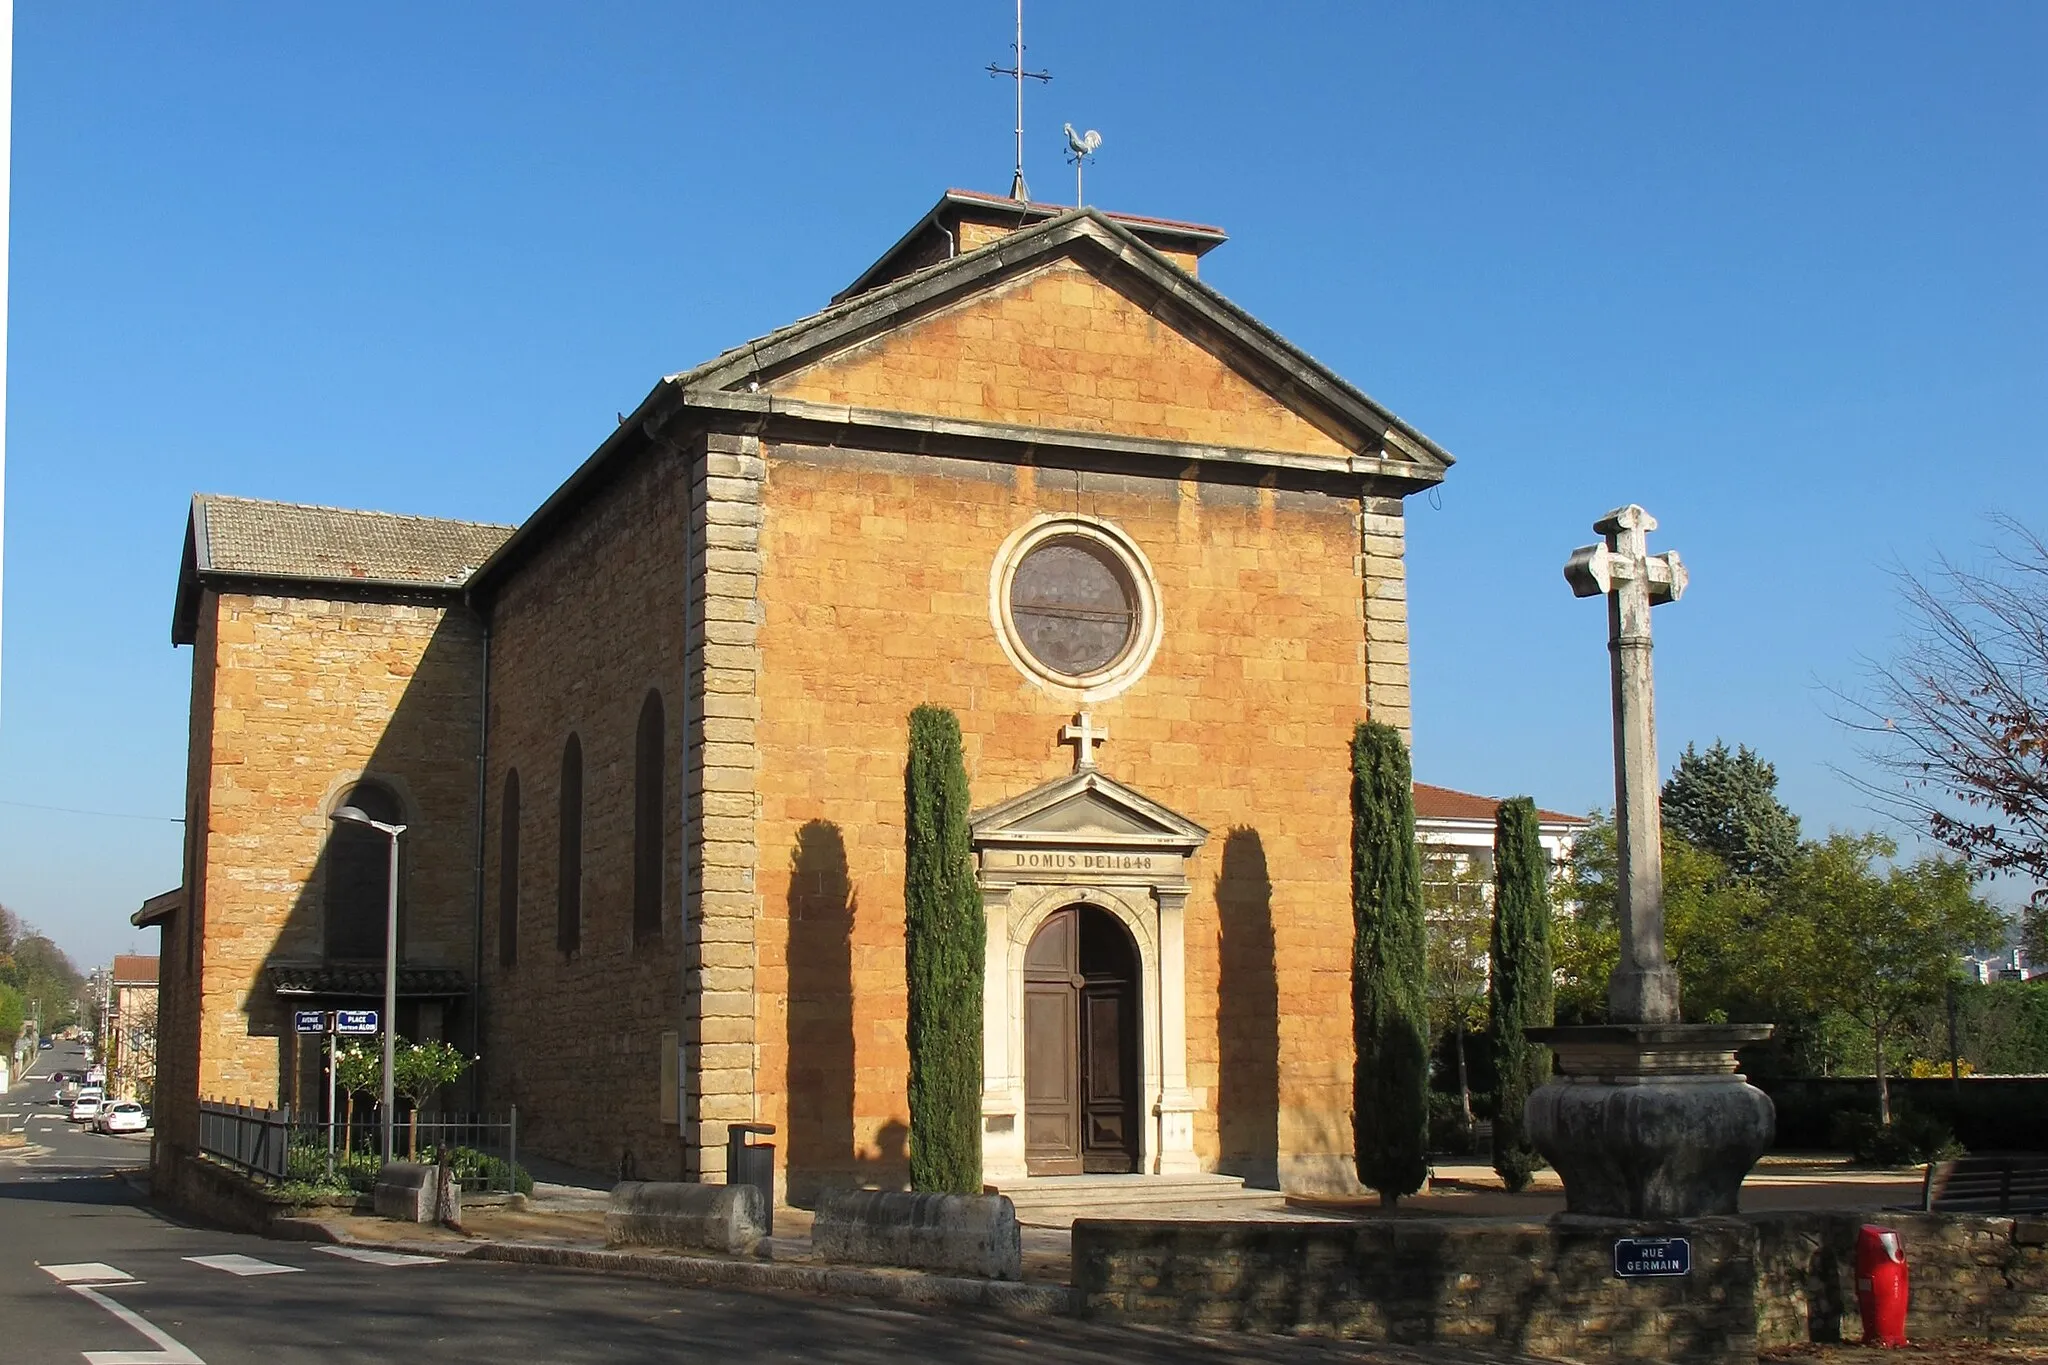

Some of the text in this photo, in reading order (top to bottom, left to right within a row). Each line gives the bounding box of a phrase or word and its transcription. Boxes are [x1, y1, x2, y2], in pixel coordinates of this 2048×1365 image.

[1016, 853, 1076, 868] DOMUS
[1641, 1248, 1664, 1258] RUE
[1626, 1260, 1679, 1271] GERMAIN
